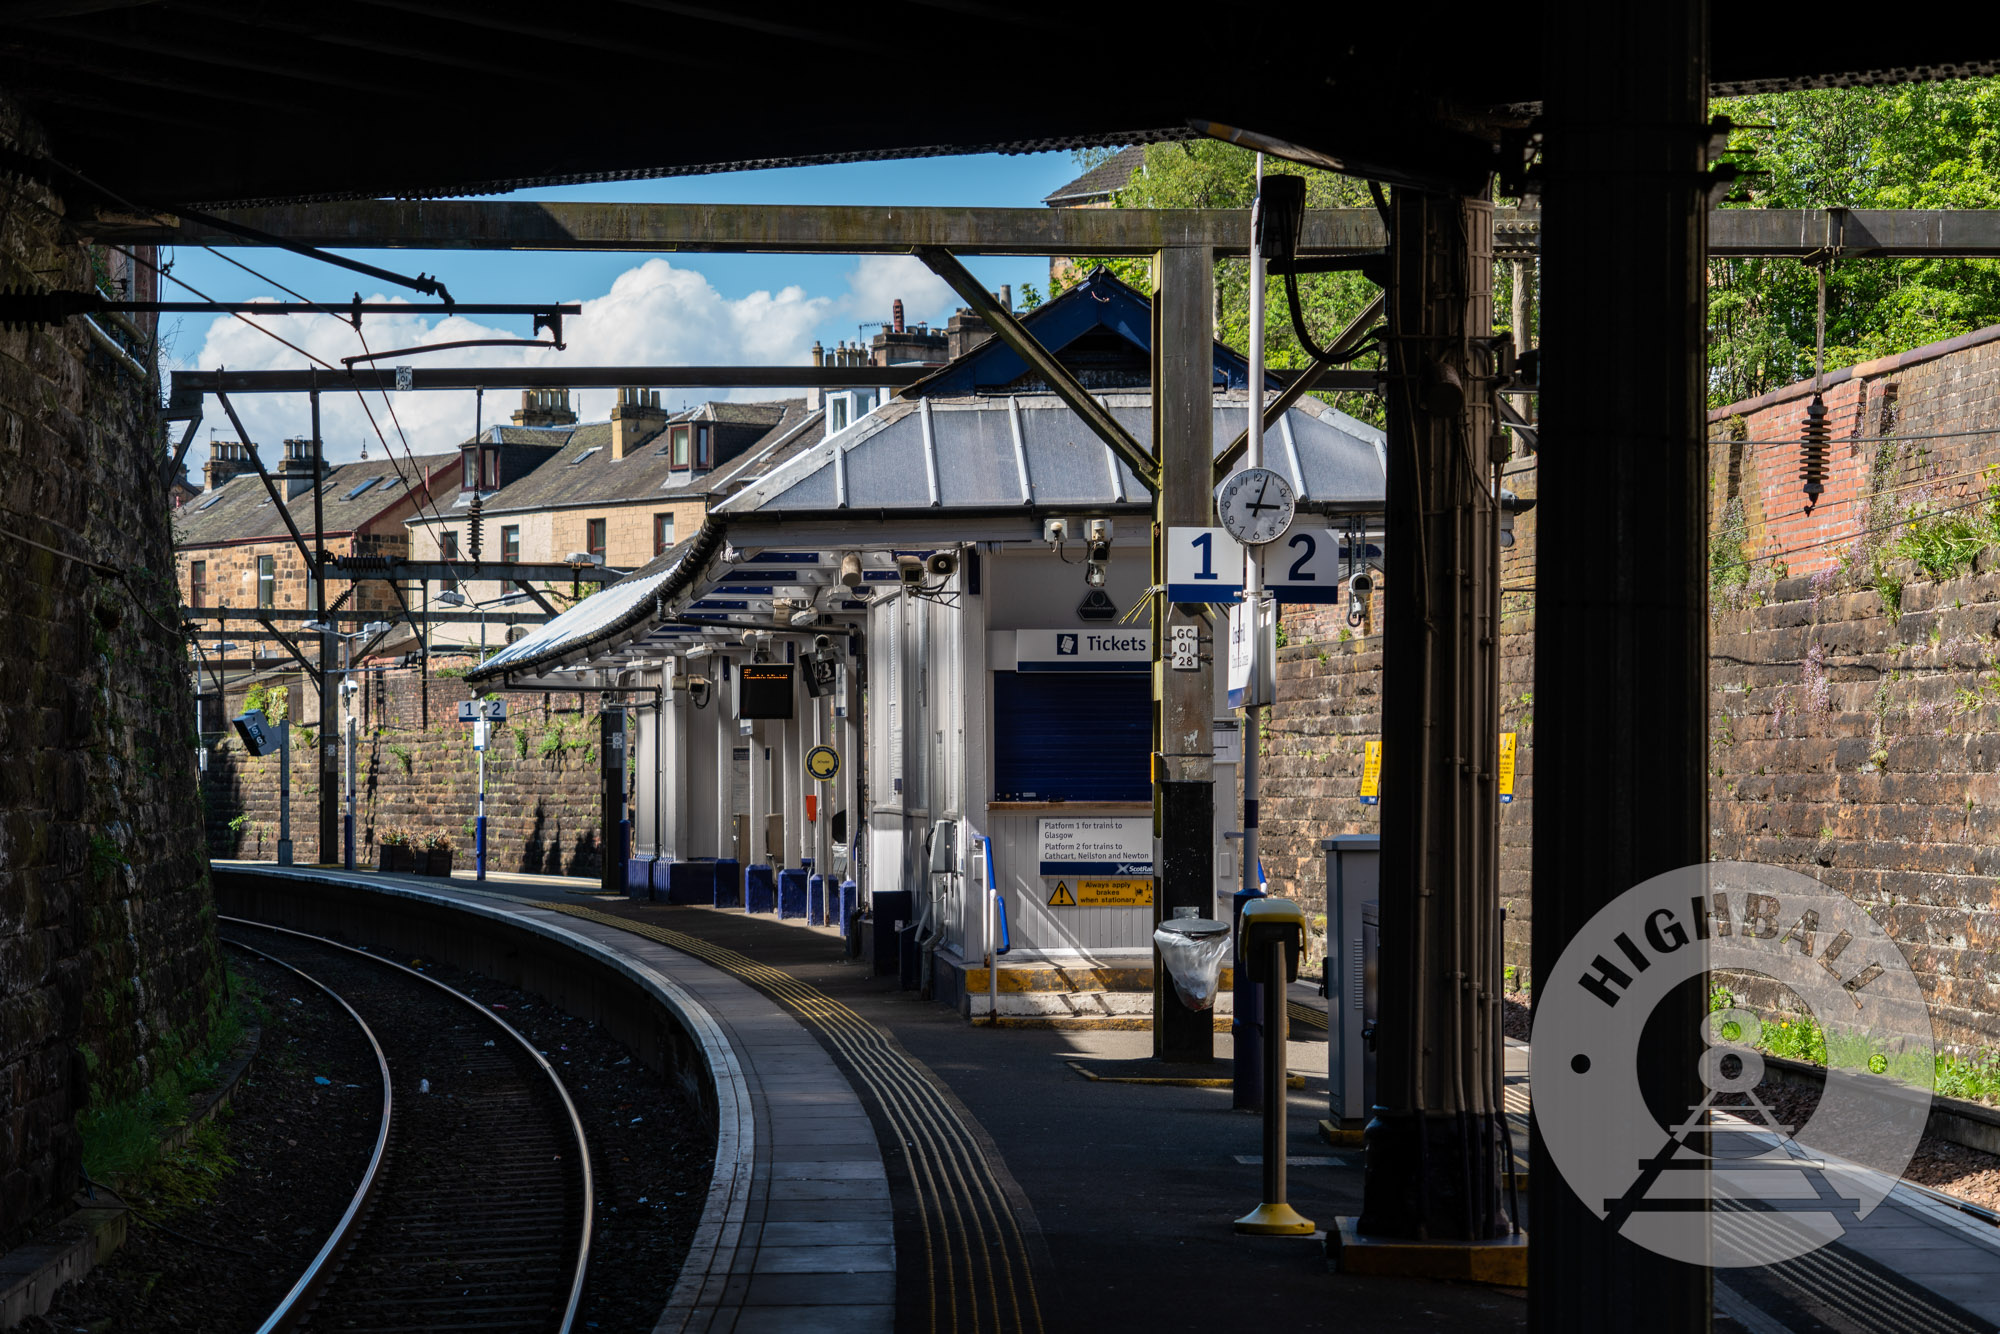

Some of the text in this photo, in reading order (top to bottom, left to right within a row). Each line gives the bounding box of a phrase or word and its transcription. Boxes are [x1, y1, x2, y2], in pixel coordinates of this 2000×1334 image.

[1240, 477, 1248, 486] 11
[1254, 472, 1262, 482] 12
[1272, 477, 1275, 486] 1
[1229, 486, 1238, 496] 10
[1280, 488, 1287, 497] 2
[1224, 501, 1231, 510] 9
[1284, 503, 1291, 512] 3
[1228, 516, 1235, 525] 8
[1278, 517, 1285, 525] 4
[1239, 526, 1246, 535] 7
[1269, 527, 1276, 536] 5
[1253, 531, 1260, 540] 6
[1192, 532, 1316, 581] 1 2
[1176, 628, 1194, 639] GC
[1086, 635, 1146, 651] Tickets
[1178, 656, 1193, 667] 28
[465, 702, 500, 716] 1 2
[1044, 822, 1074, 830] Platform
[1044, 832, 1074, 840] Glasgow
[1044, 852, 1076, 860] Cathcart,
